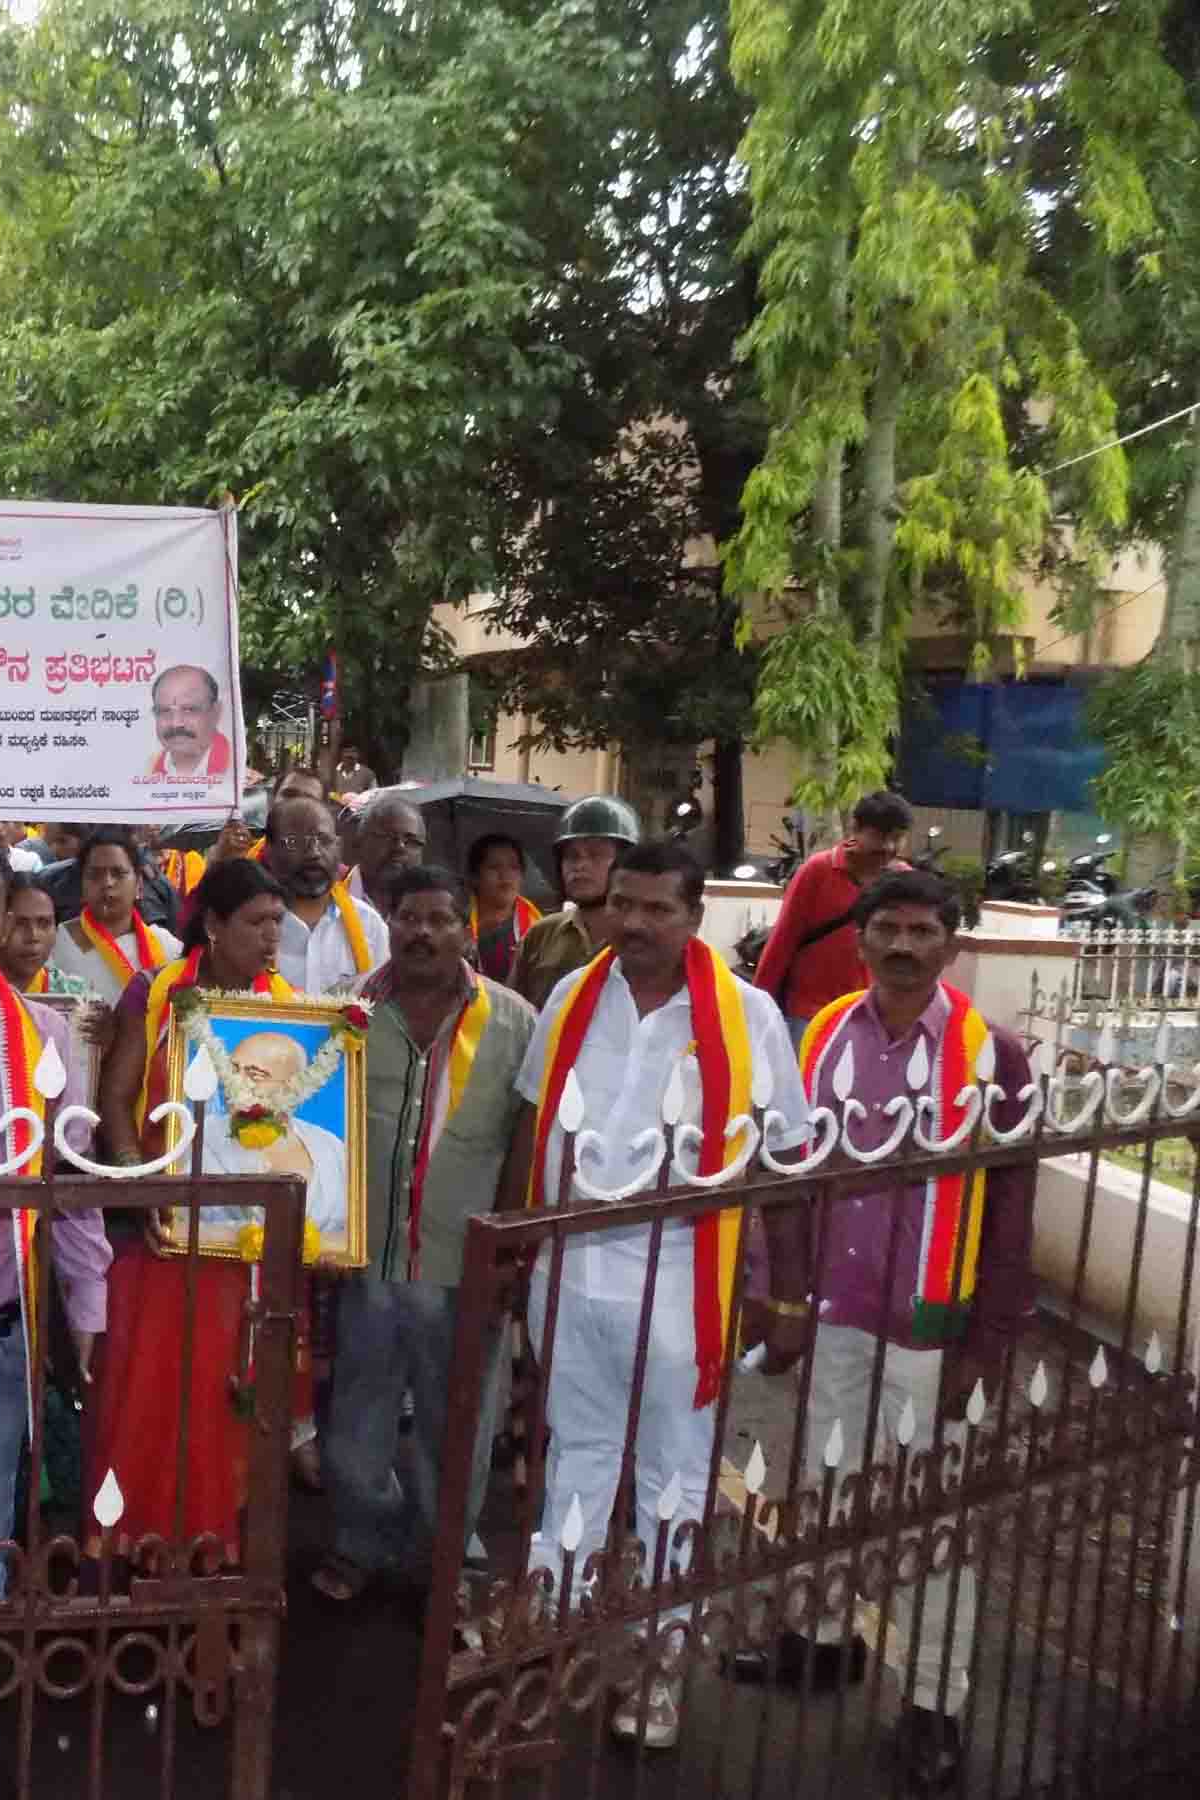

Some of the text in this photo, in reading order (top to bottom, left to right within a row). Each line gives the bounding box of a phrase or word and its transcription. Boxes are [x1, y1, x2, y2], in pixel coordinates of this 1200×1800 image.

[50, 584, 138, 620] ವೇದಿಕೆ
[155, 586, 205, 628] (ರಿ.)
[45, 649, 158, 694] ಪ್ರತಿಭಟನೆ
